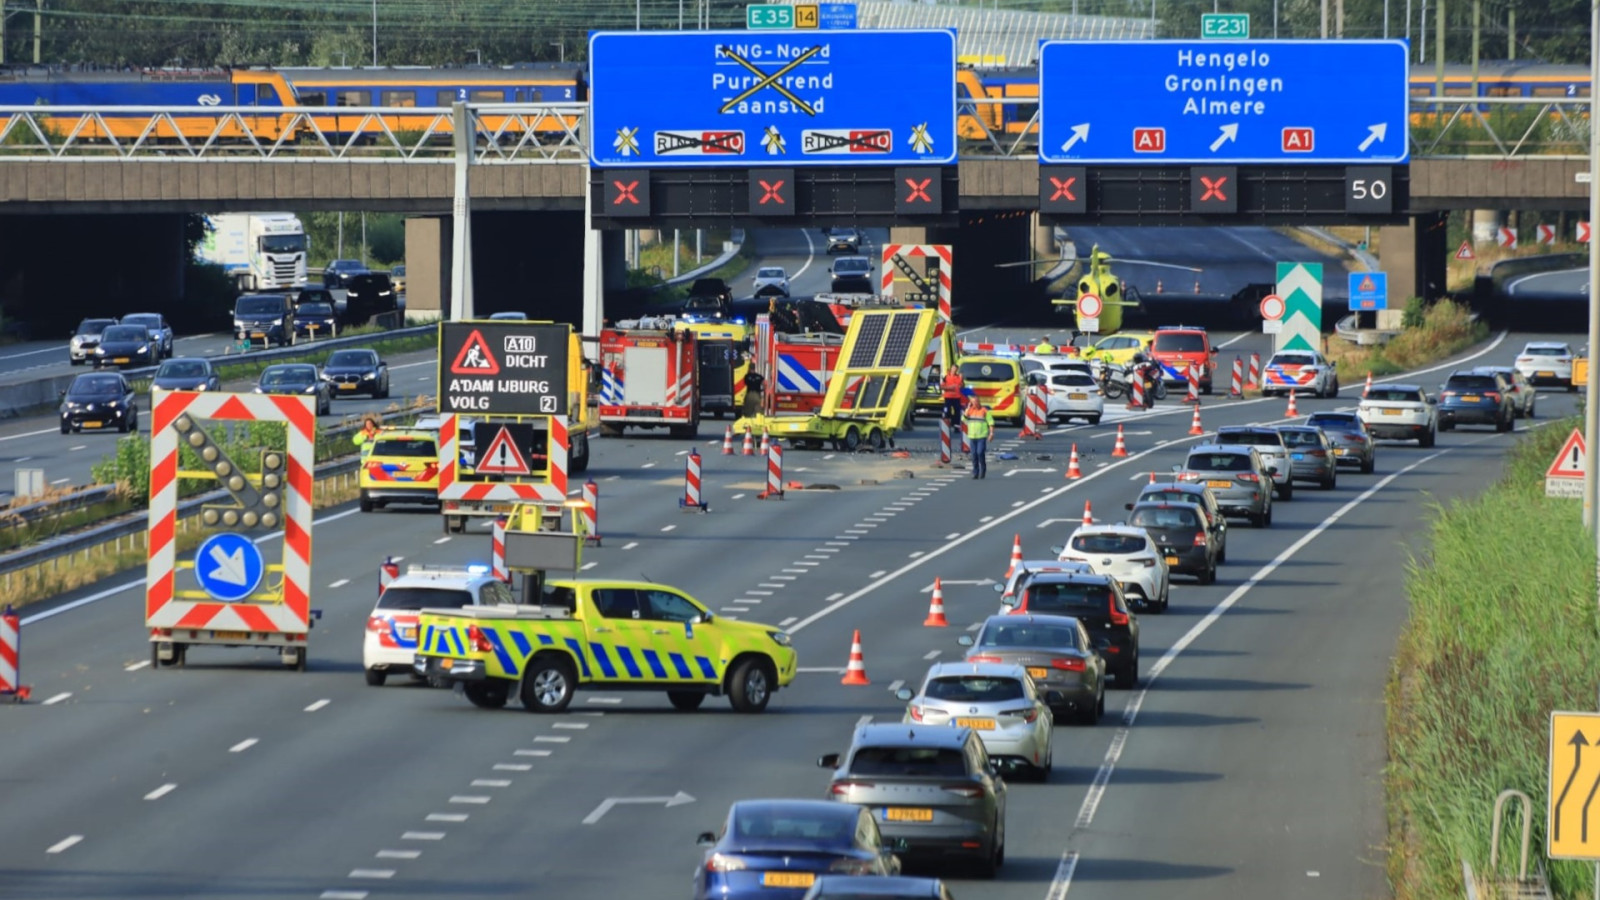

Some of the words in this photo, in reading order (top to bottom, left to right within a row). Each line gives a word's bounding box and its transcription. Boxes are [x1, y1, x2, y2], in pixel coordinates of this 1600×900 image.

[752, 10, 762, 24] E
[766, 10, 790, 24] 35
[799, 11, 815, 23] 14
[1204, 18, 1247, 35] E231
[1178, 48, 1270, 72] Hengelo
[564, 88, 572, 98] 2
[1164, 74, 1283, 97] Groningen
[1567, 84, 1576, 95] 2
[460, 89, 467, 98] 2
[1182, 96, 1266, 115] Almere
[657, 137, 698, 151] RIN
[1138, 131, 1161, 148] A1
[1286, 131, 1310, 148] A1
[1352, 179, 1387, 200] 50
[507, 337, 532, 351] A10
[505, 354, 548, 368] DICHT
[449, 378, 494, 393] A'DAM
[497, 380, 549, 394] IJBURG
[449, 395, 490, 410] VOLG
[543, 398, 552, 410] 2
